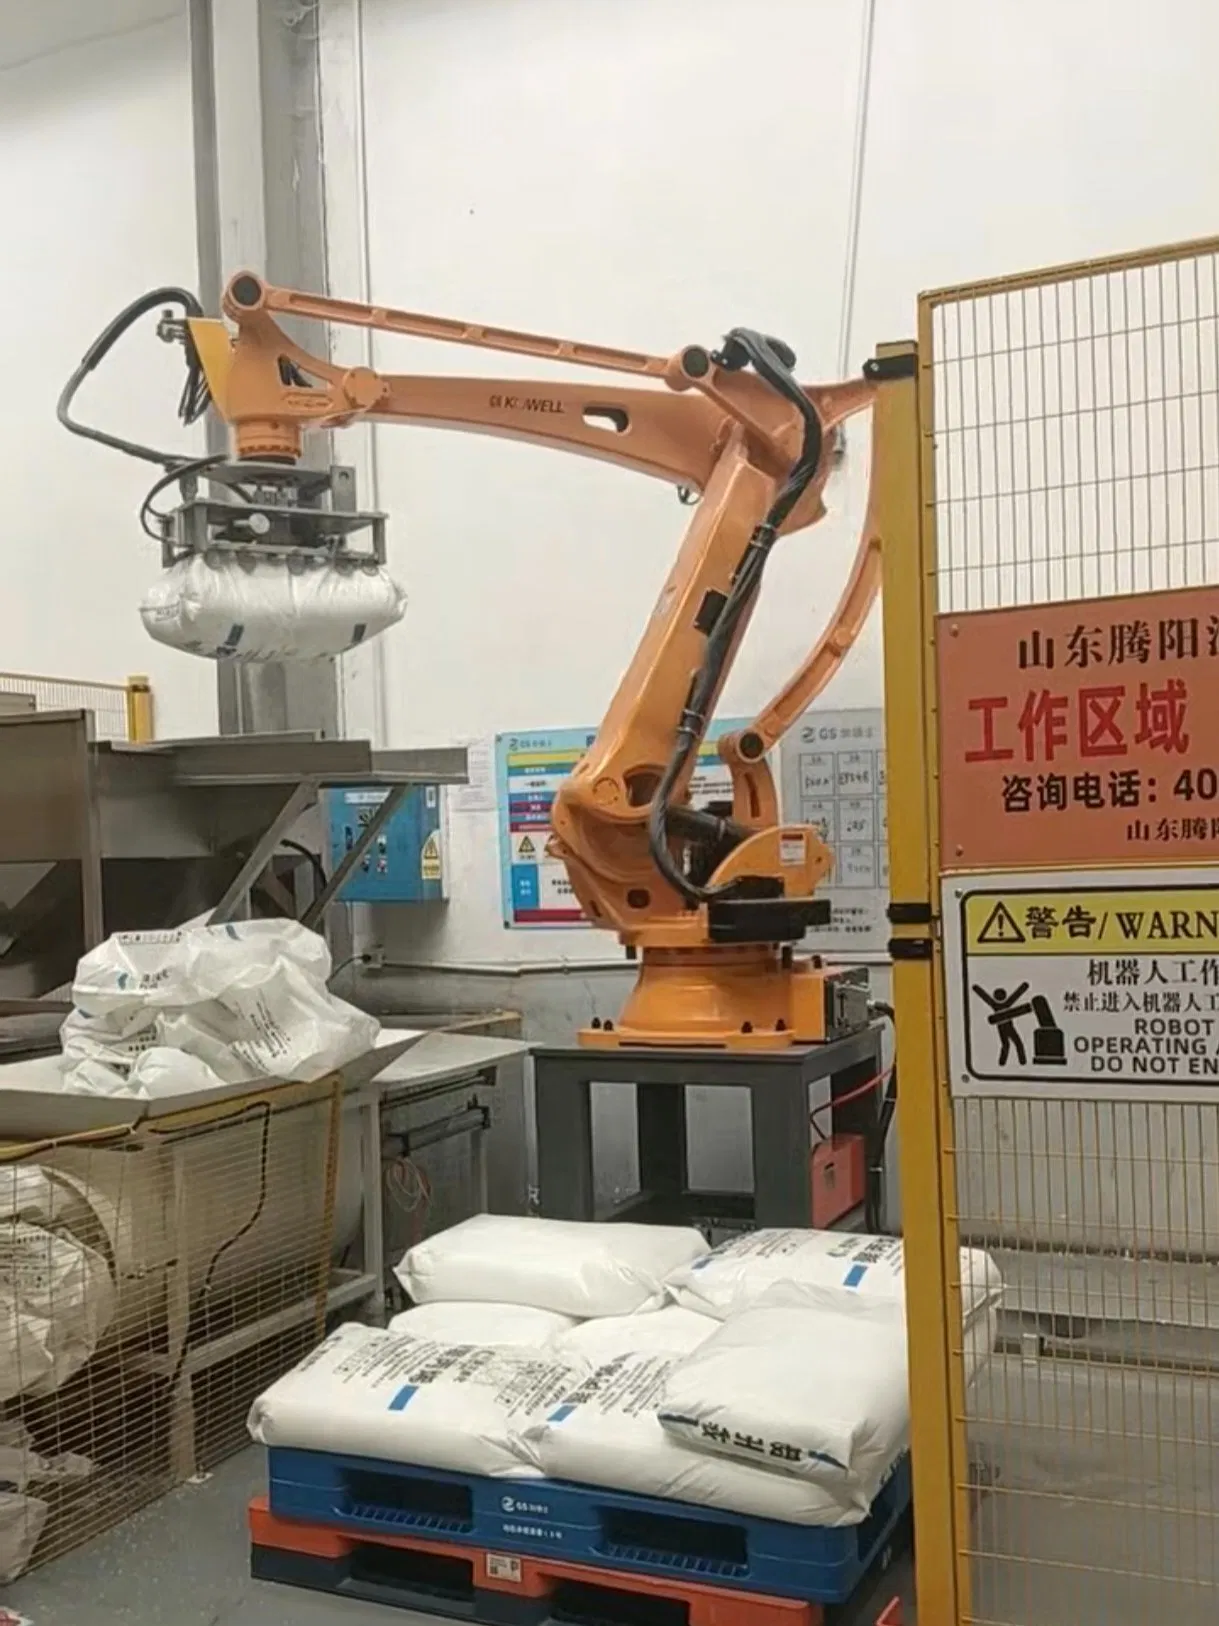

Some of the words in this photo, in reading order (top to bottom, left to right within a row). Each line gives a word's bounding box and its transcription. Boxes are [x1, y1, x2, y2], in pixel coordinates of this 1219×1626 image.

[965, 679, 1189, 763] 工作区域
[1087, 958, 1219, 986] 机器人工作
[1135, 1018, 1215, 1037] ROBOT
[1073, 1036, 1207, 1056] OPERATING
[1091, 1056, 1123, 1073] DO
[1132, 1056, 1180, 1075] NOT
[1189, 1057, 1219, 1076] EN
